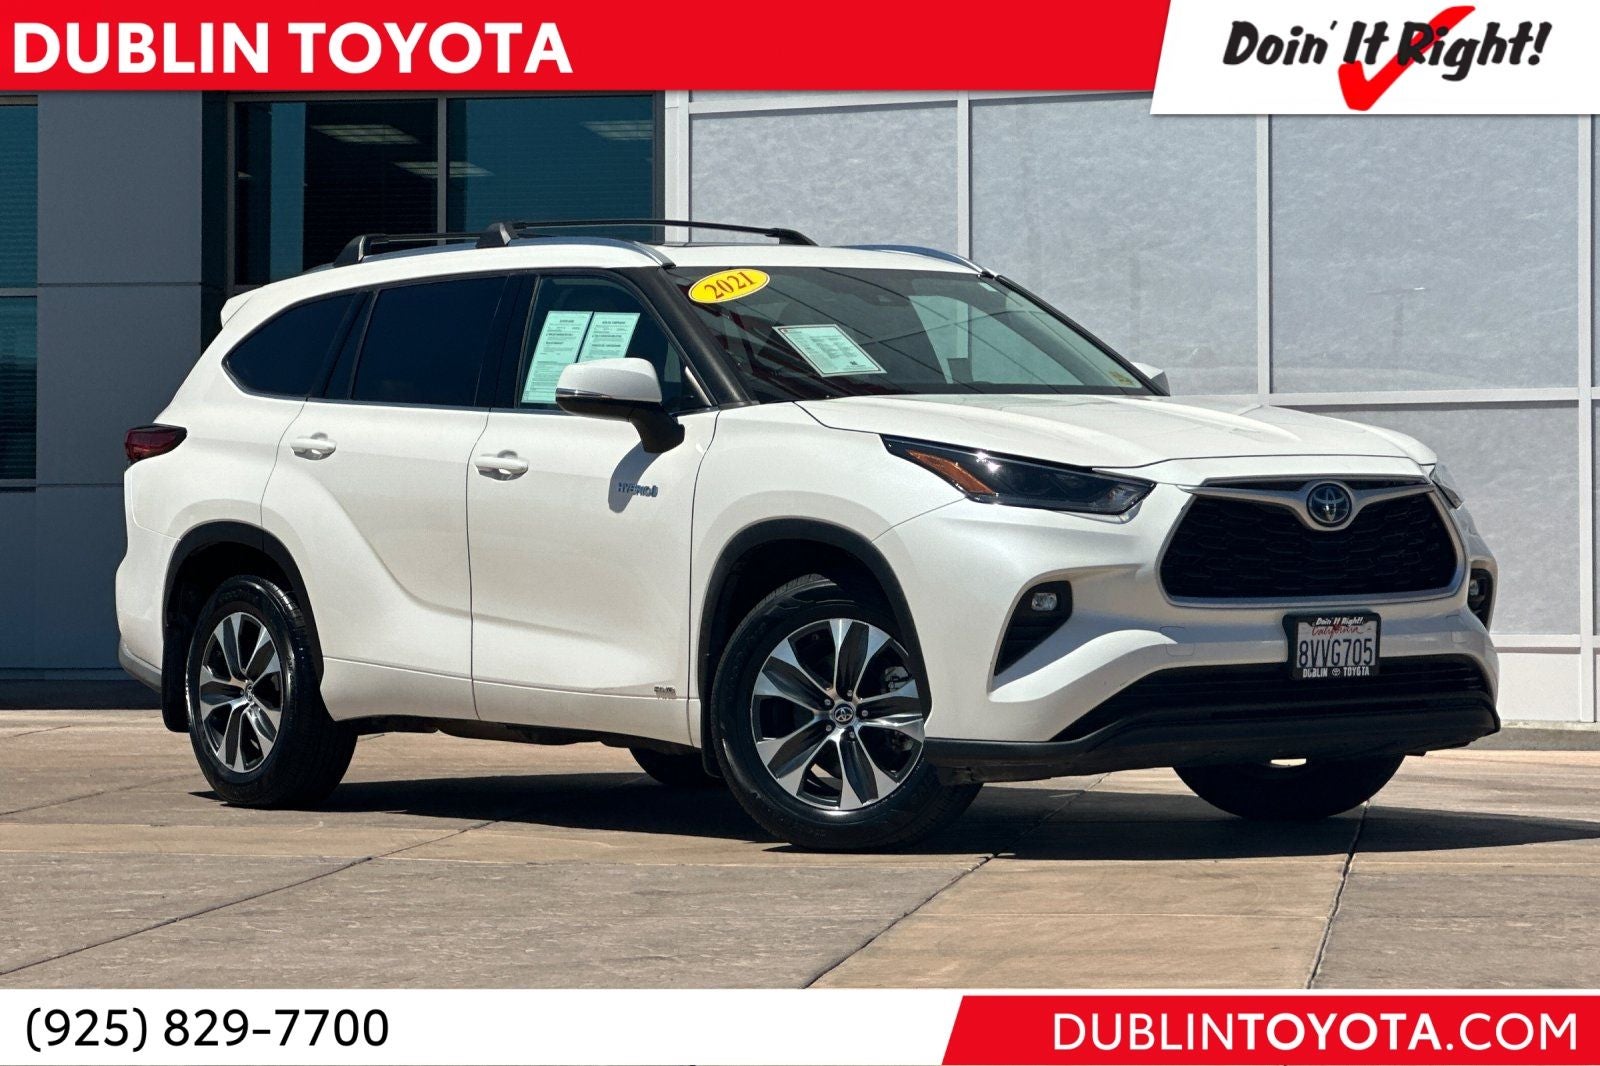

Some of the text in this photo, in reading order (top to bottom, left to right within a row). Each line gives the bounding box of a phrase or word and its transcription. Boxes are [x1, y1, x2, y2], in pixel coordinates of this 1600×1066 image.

[704, 271, 757, 299] 2021
[1299, 638, 1373, 668] 8VVG705
[1302, 666, 1370, 678] DUBLIN TOYOTA
